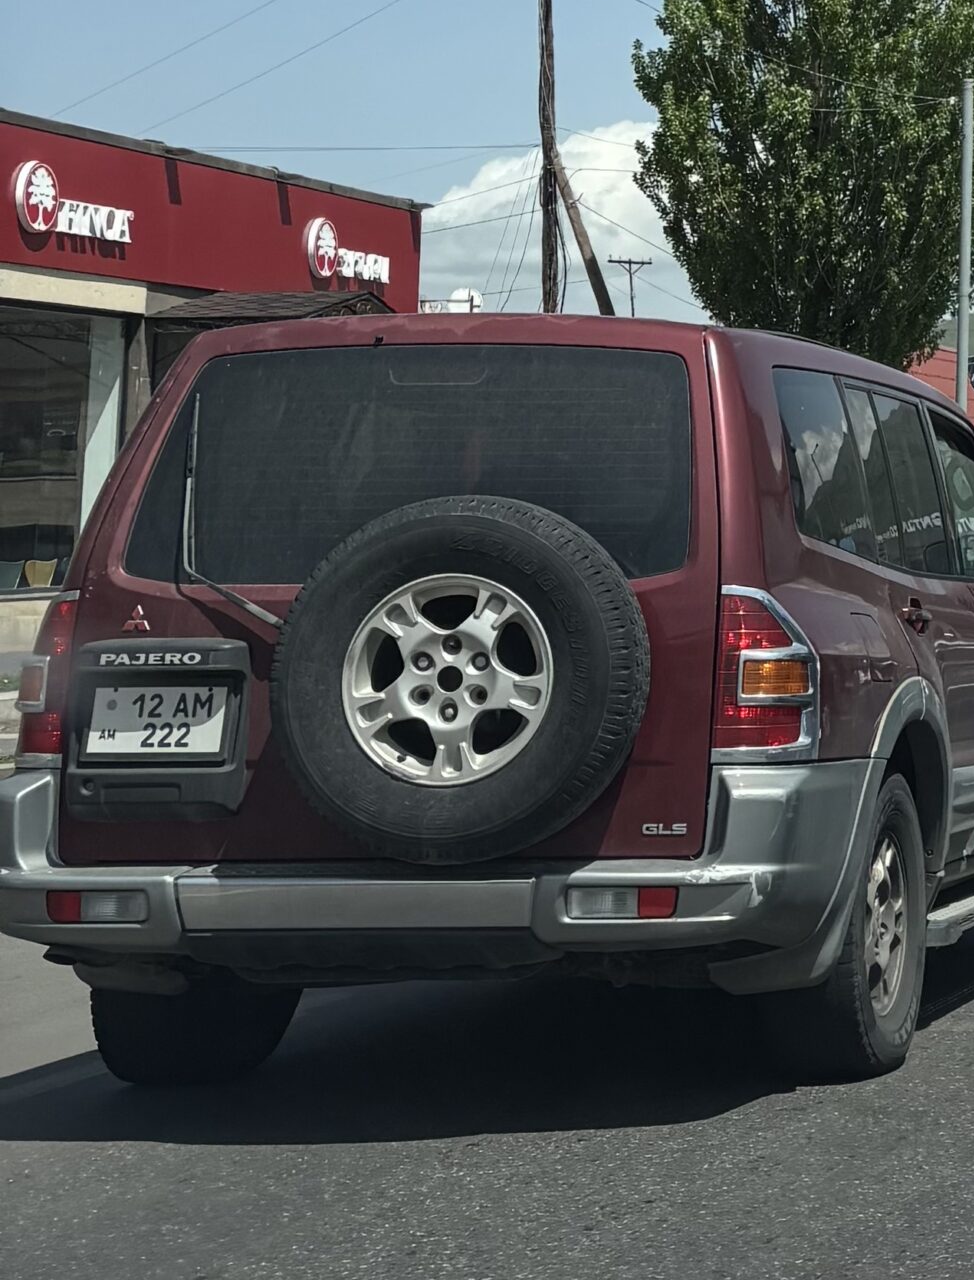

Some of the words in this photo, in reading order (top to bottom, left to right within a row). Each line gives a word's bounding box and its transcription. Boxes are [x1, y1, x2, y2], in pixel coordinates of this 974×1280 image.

[99, 652, 201, 665] PAJERO
[132, 693, 164, 718] 12
[172, 692, 214, 718] AM
[98, 729, 116, 740] AM
[140, 722, 191, 748] 222
[642, 823, 687, 835] GLS
